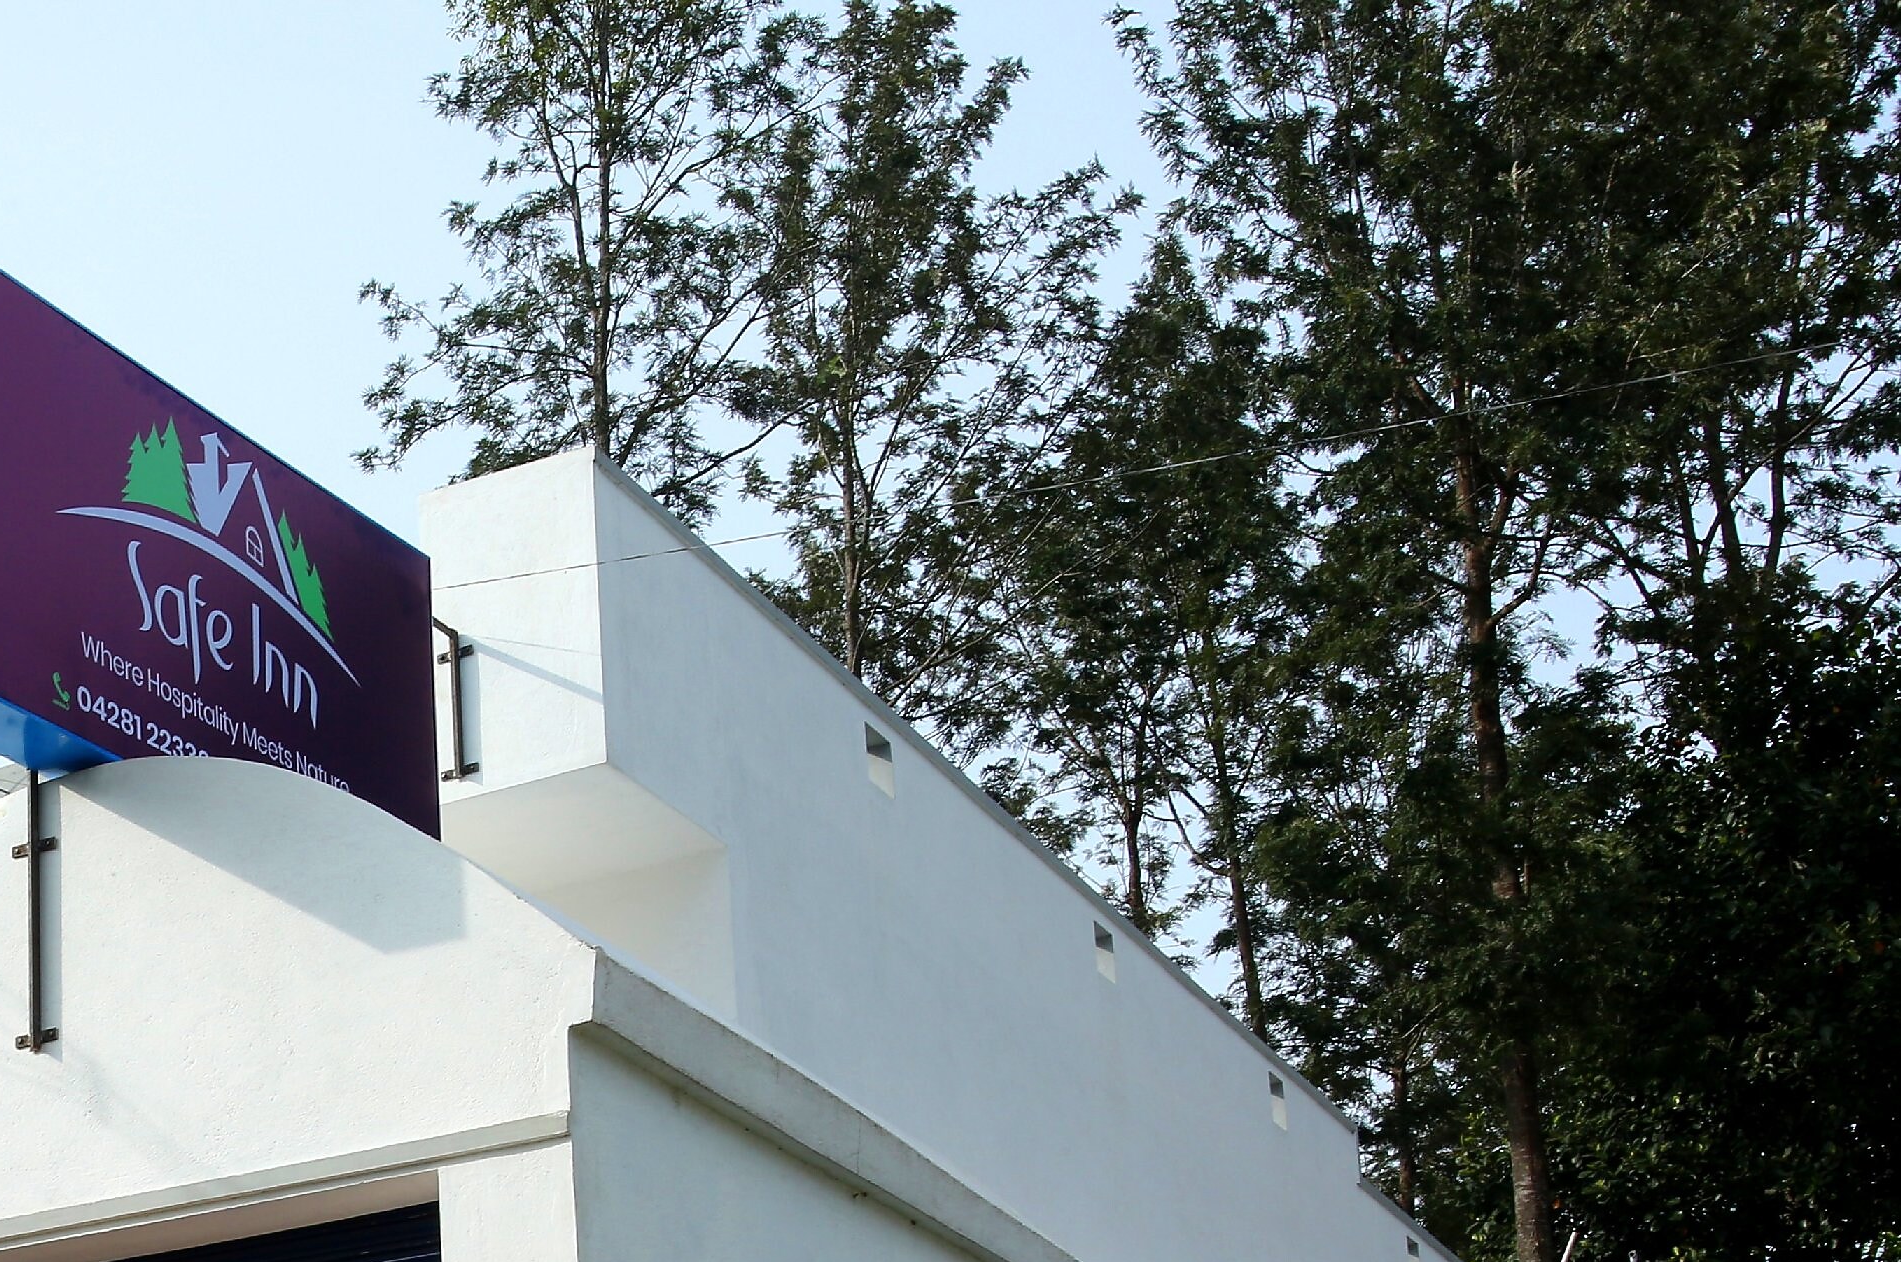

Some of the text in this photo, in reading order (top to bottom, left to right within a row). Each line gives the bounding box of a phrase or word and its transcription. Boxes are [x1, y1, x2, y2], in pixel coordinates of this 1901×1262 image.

[81, 631, 144, 687] Where
[147, 668, 239, 745] Hospitality
[242, 721, 293, 769] Meets
[127, 540, 318, 729] Safe Inn
[76, 685, 142, 741] 04281
